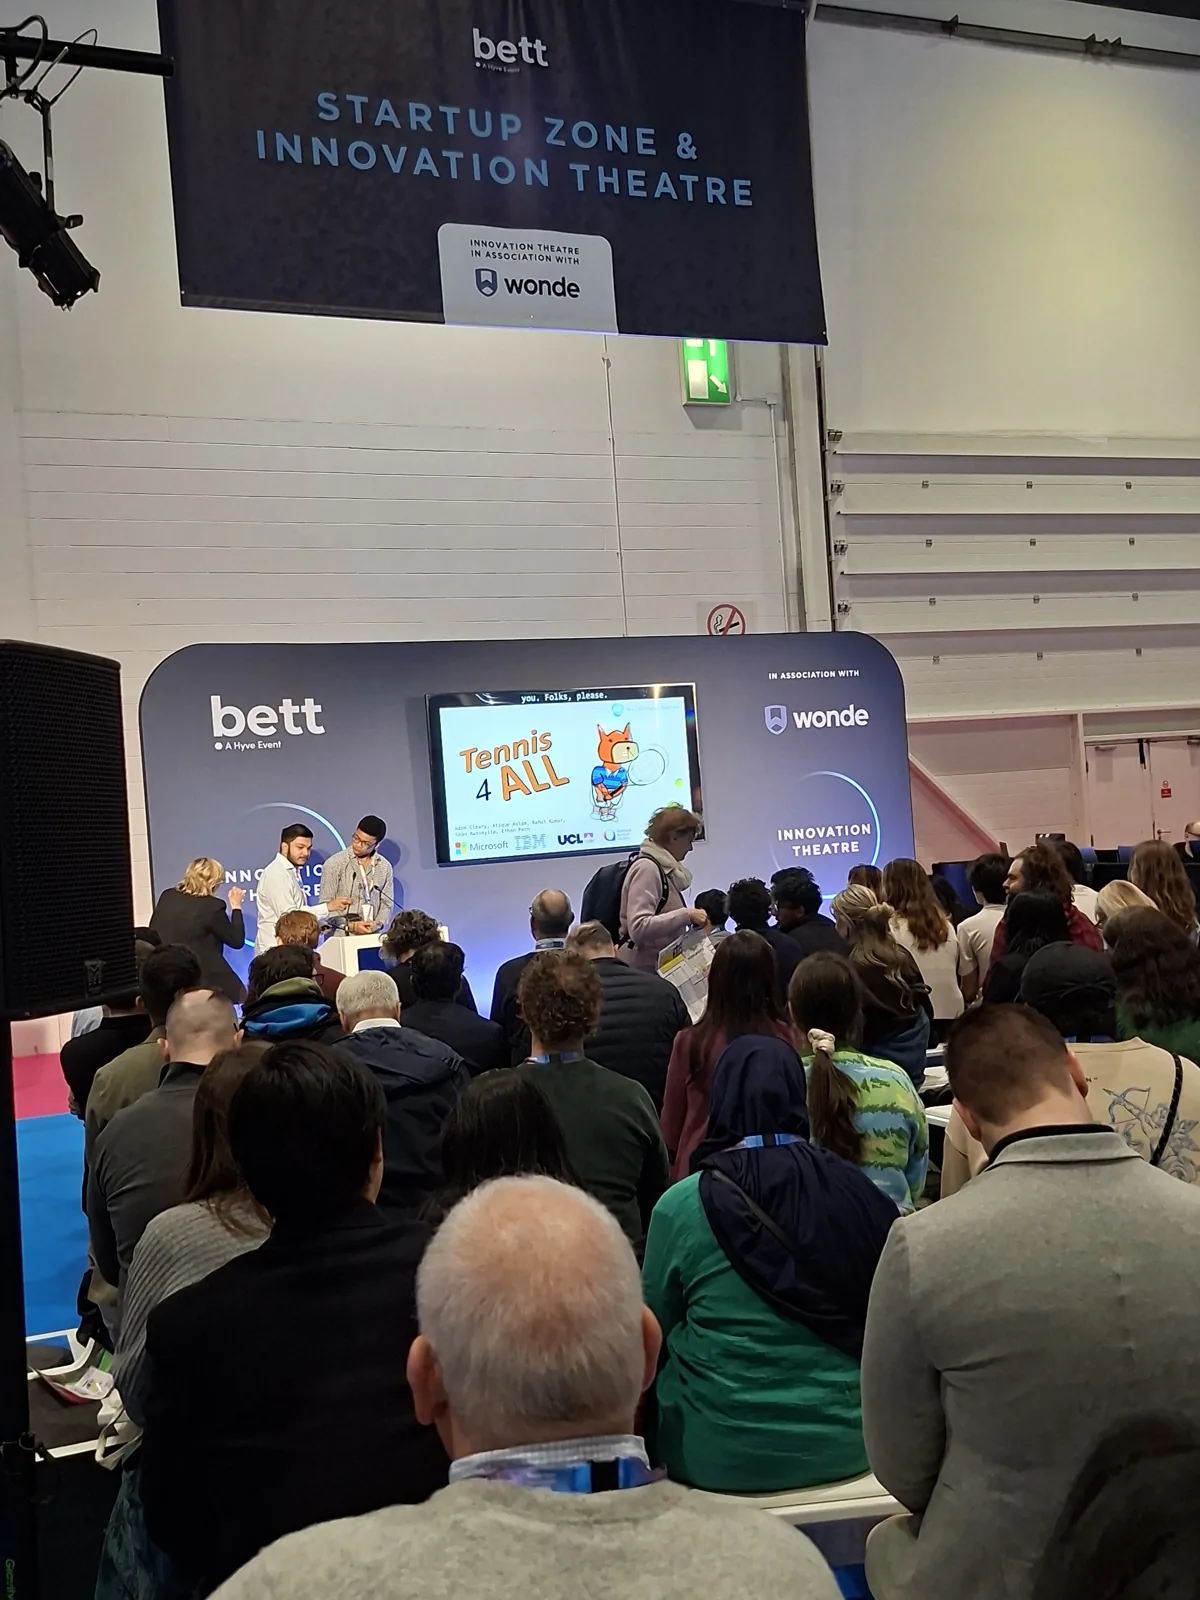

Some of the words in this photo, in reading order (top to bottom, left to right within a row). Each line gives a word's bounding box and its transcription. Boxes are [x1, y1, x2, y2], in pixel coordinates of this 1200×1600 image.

[472, 27, 549, 67] bett
[317, 92, 522, 141] STARTUP
[544, 116, 657, 156] ZONE
[676, 132, 698, 160] &
[256, 129, 549, 187] INNOVATION
[569, 163, 753, 207] THEATRE
[470, 239, 534, 251] INNOVATION
[538, 244, 580, 255] THEATRE
[471, 250, 481, 258] IN
[485, 250, 552, 262] ASSOCIATION
[555, 256, 580, 265] WITH
[504, 276, 580, 298] wonde
[768, 672, 778, 680] IN
[780, 670, 836, 680] ASSOCIATION
[838, 669, 860, 678] WITH
[520, 695, 540, 705] you.
[544, 692, 572, 702] Folks,
[576, 690, 608, 702] please.
[210, 695, 326, 738] bett
[792, 704, 870, 729] wonde
[225, 741, 232, 750] A
[233, 741, 256, 752] Hyve
[257, 740, 282, 750] Event
[459, 729, 552, 773] Tennis
[475, 778, 492, 801] 4
[501, 754, 571, 801] ALL
[557, 833, 583, 846] UCL
[777, 823, 872, 841] INNOVATION
[469, 840, 509, 851] Microsoft
[792, 841, 860, 857] THEATRE
